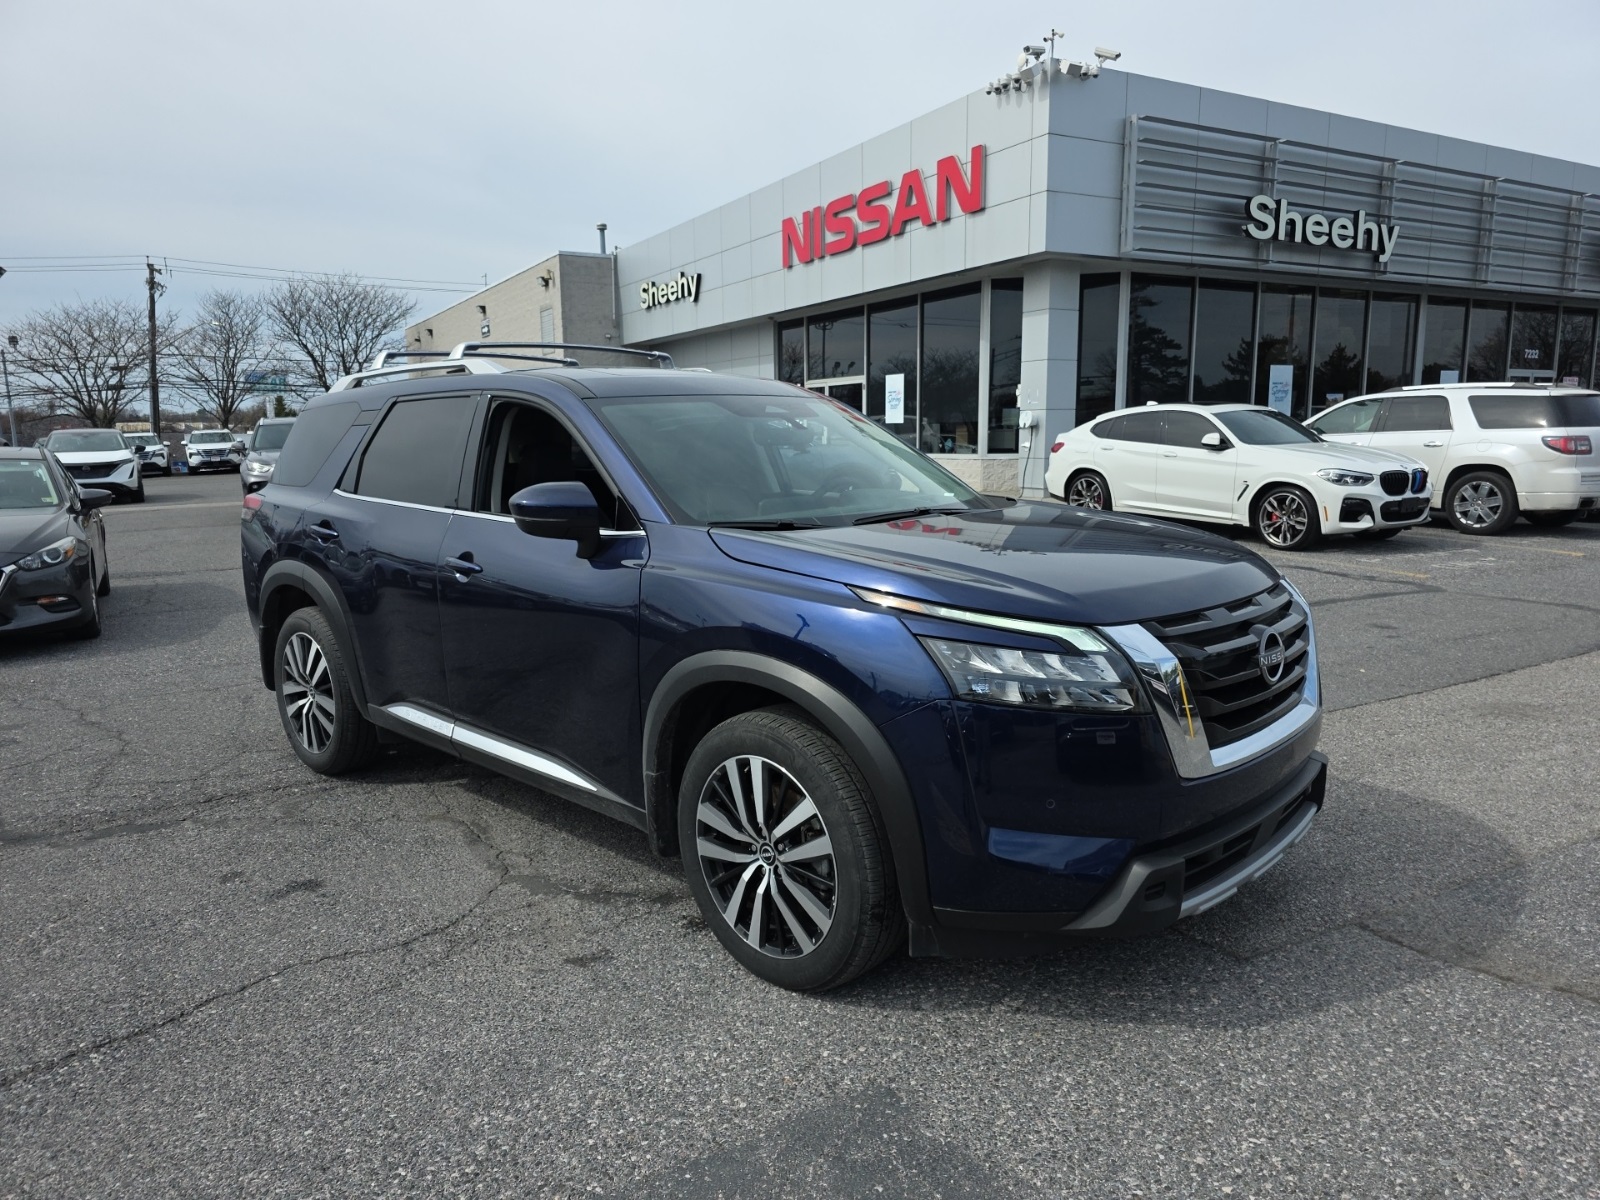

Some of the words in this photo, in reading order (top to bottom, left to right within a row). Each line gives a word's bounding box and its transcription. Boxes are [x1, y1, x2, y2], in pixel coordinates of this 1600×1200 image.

[782, 144, 984, 269] NISSAN
[1247, 195, 1400, 263] Sheehy
[640, 272, 700, 309] Sheehy
